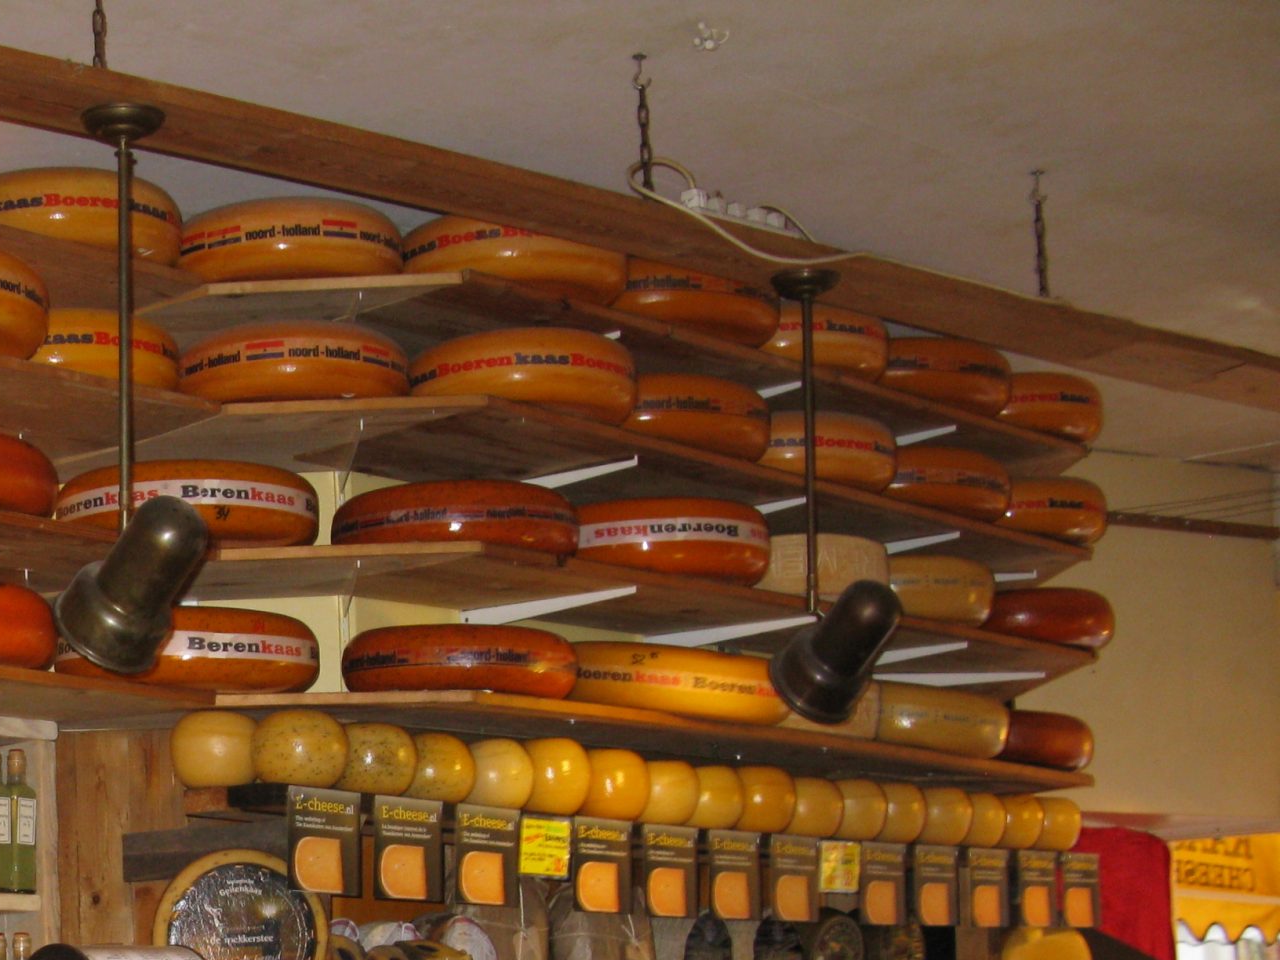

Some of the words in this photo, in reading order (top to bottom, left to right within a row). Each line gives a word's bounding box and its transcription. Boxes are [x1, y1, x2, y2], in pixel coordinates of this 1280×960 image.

[245, 223, 321, 241] noord-holland
[437, 357, 512, 376] Boeren
[295, 795, 354, 816] E-cheese.nl
[382, 806, 437, 823] E-cheese.nl
